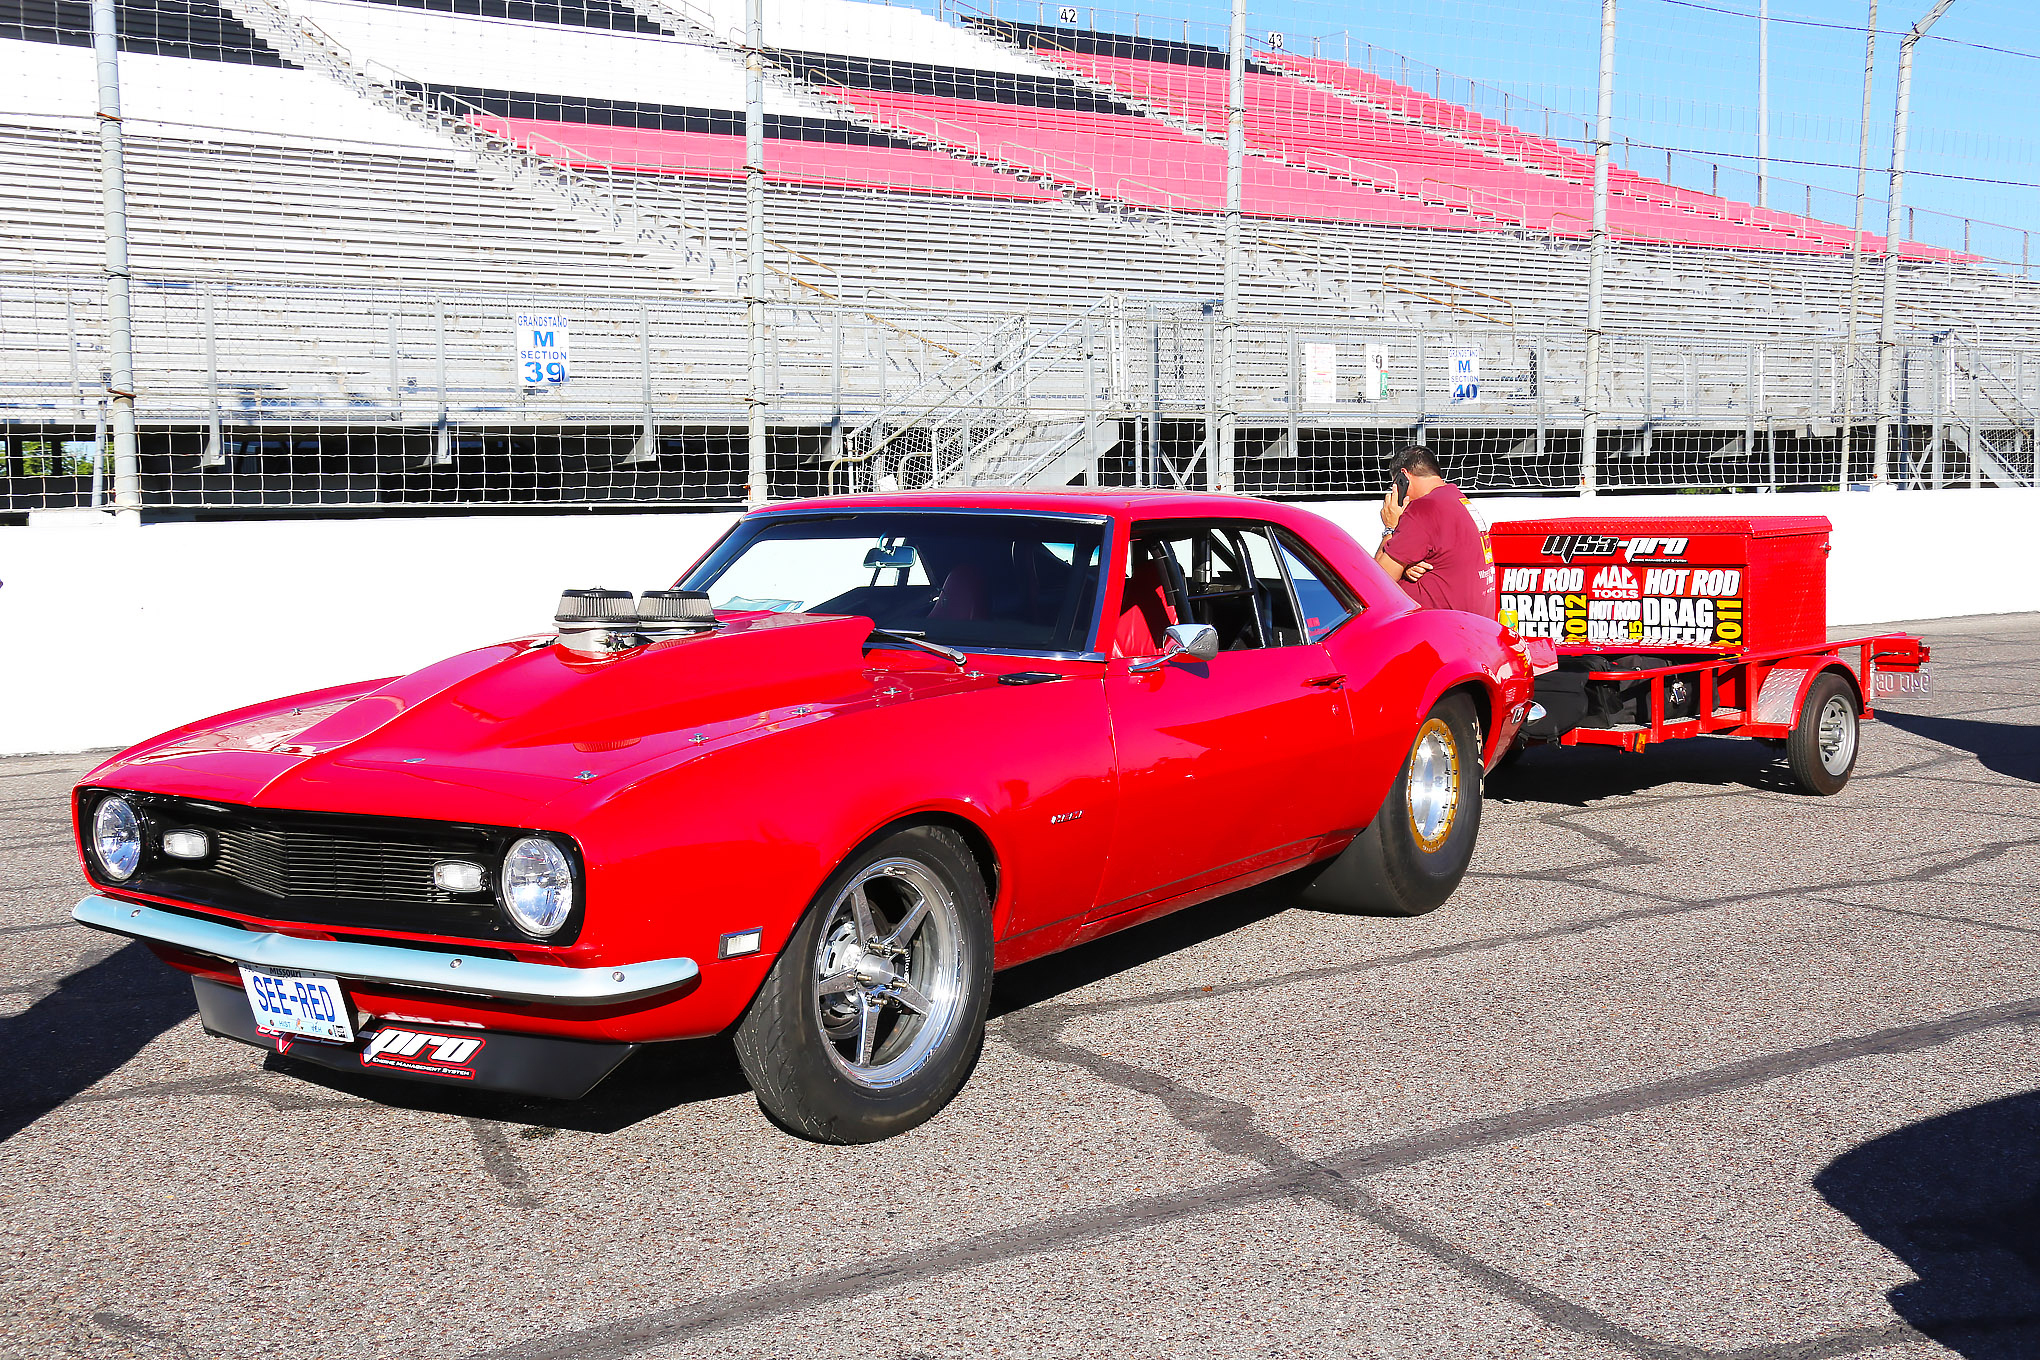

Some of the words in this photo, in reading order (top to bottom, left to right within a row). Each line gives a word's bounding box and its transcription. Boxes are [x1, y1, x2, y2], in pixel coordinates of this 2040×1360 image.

[1060, 8, 1077, 23] 42
[1268, 33, 1283, 48] 43
[517, 315, 568, 328] GRANDSTAND
[533, 330, 554, 348] M
[520, 350, 567, 360] SECTION
[524, 361, 566, 383] 39
[1458, 360, 1471, 373] M
[1450, 375, 1479, 383] SECTION
[1453, 383, 1478, 399] 40
[1502, 567, 1542, 592] HOT
[1542, 567, 1584, 592] ROD
[1592, 565, 1639, 589] MAC
[1644, 568, 1691, 596] HOT
[1691, 569, 1741, 597] ROD
[1592, 589, 1639, 599] TOOLS
[1501, 594, 1565, 622] DRAG
[1589, 600, 1615, 620] HOT
[1614, 600, 1641, 620] ROD
[1643, 598, 1714, 628] DRAG
[1588, 620, 1629, 639] DRAG
[253, 975, 335, 1022] SEE-RED
